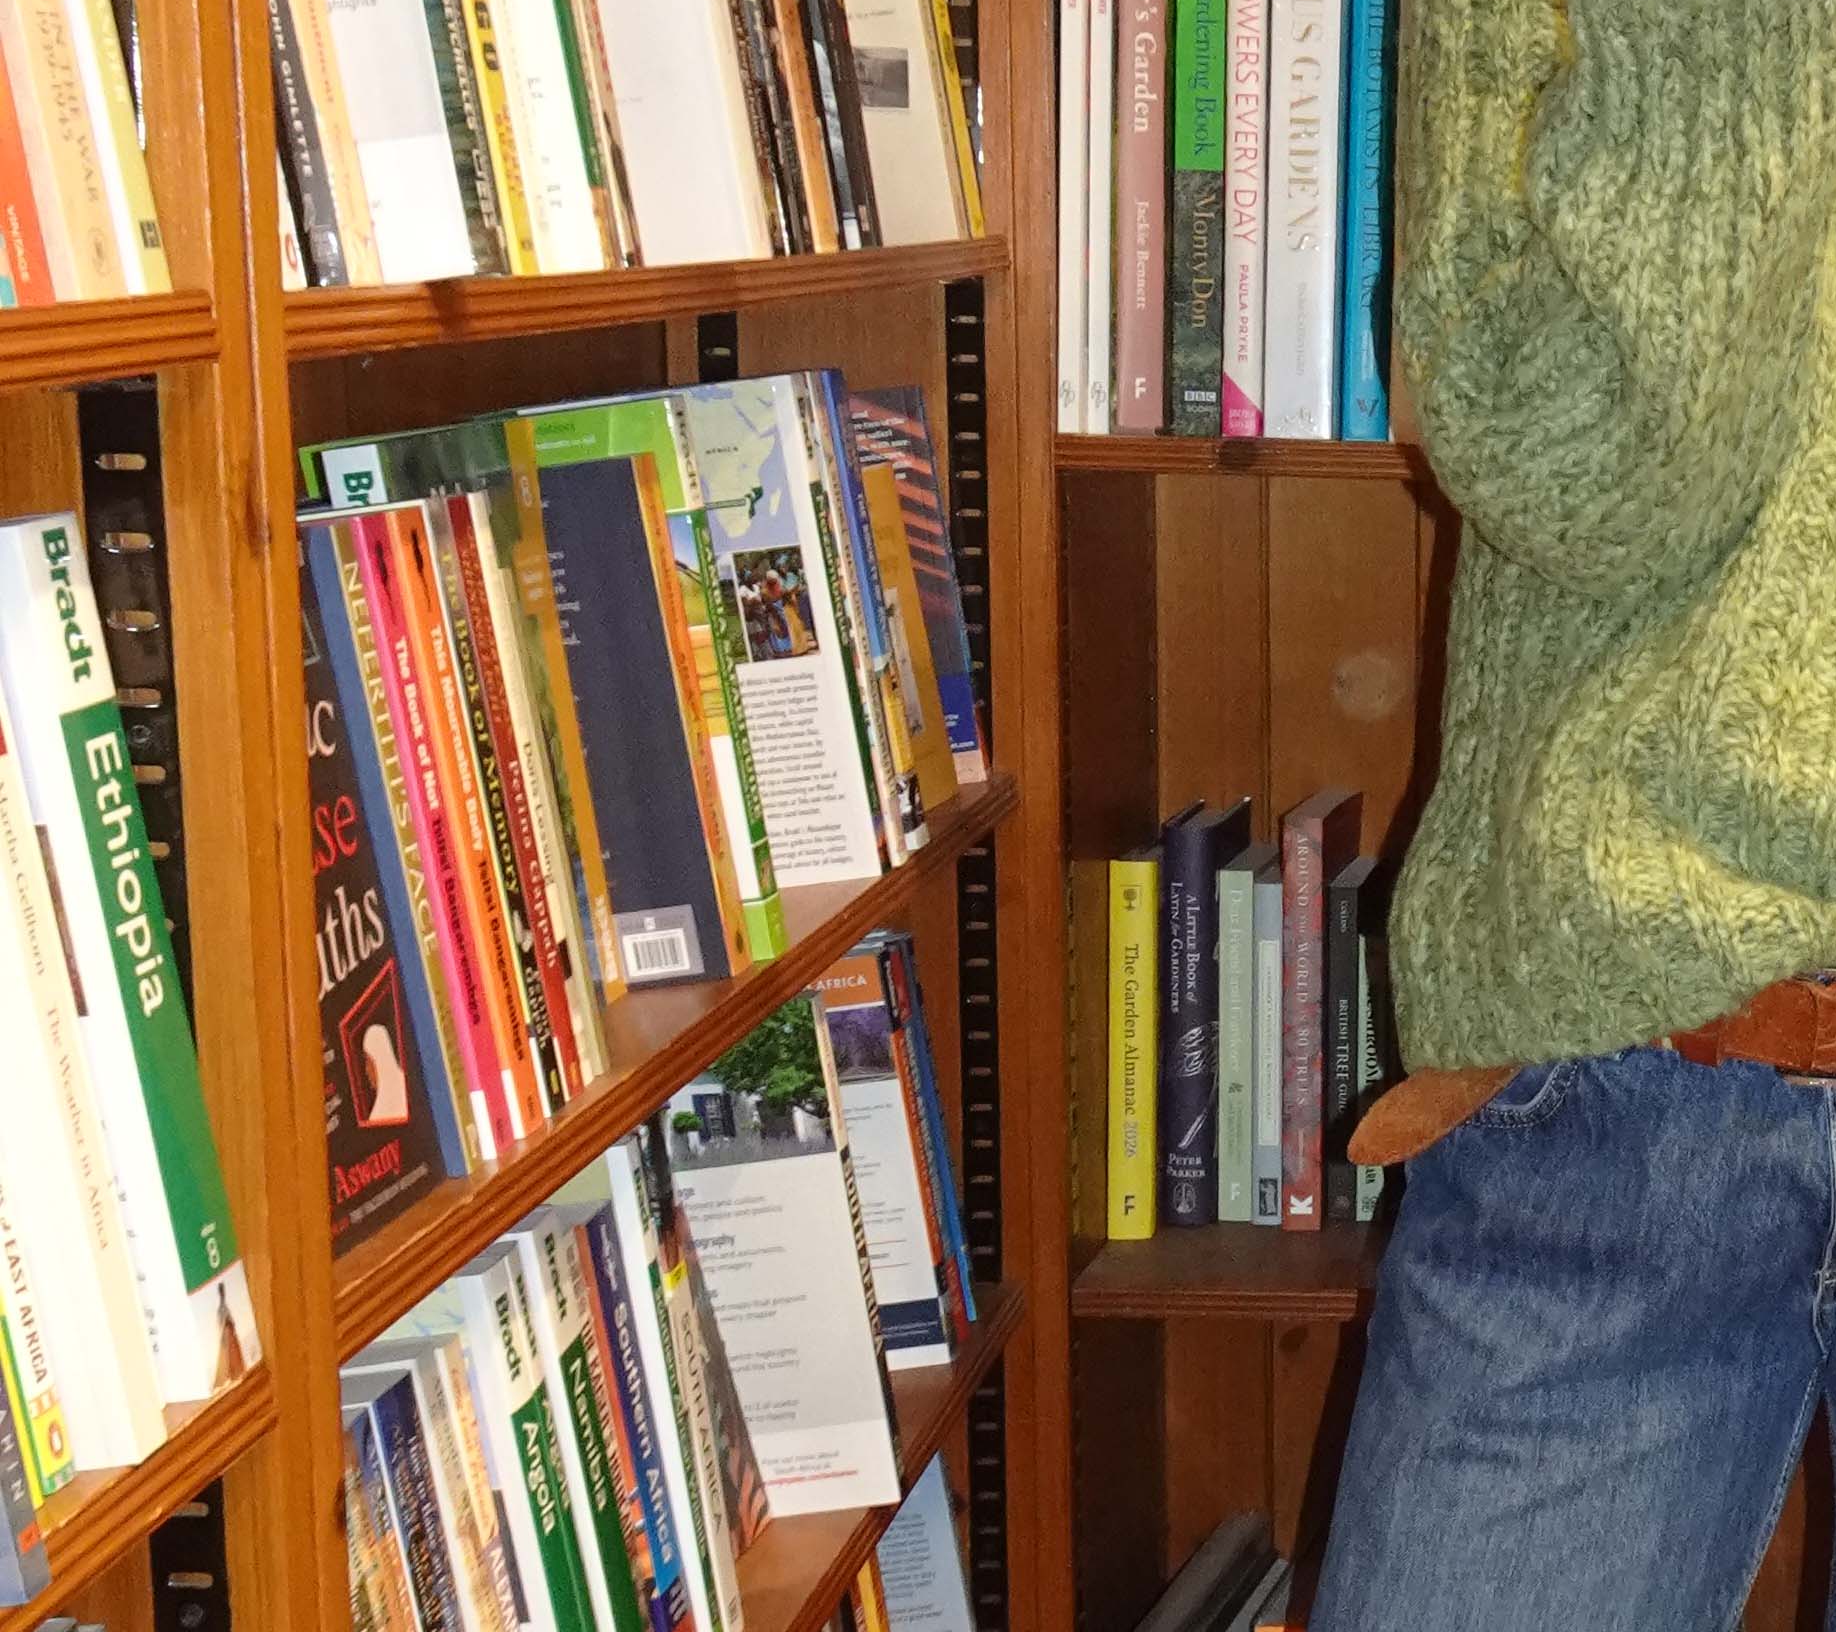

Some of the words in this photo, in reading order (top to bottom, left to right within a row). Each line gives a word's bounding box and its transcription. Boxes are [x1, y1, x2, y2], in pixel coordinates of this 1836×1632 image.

[1132, 30, 1157, 135] Garden
[1193, 99, 1213, 156] Book
[1234, 91, 1261, 183] EVERY
[1286, 56, 1323, 253] GARDENS
[1192, 196, 1218, 274] Monty
[1232, 189, 1258, 243] DAY
[1190, 275, 1212, 328] Don
[1238, 264, 1249, 312] PAULA
[1237, 317, 1249, 364] PRYKE
[42, 526, 92, 684] Bradt
[86, 732, 164, 1018] Ethiopia
[403, 842, 438, 953] FACE
[1125, 944, 1140, 973] The
[1124, 979, 1140, 1041] Garden
[1123, 1043, 1139, 1118] Almanac
[495, 1291, 522, 1382] Bradt
[569, 1356, 608, 1511] Namibia
[614, 1301, 653, 1459] Southern
[646, 1468, 673, 1564] Africa
[522, 1421, 555, 1536] Angola
